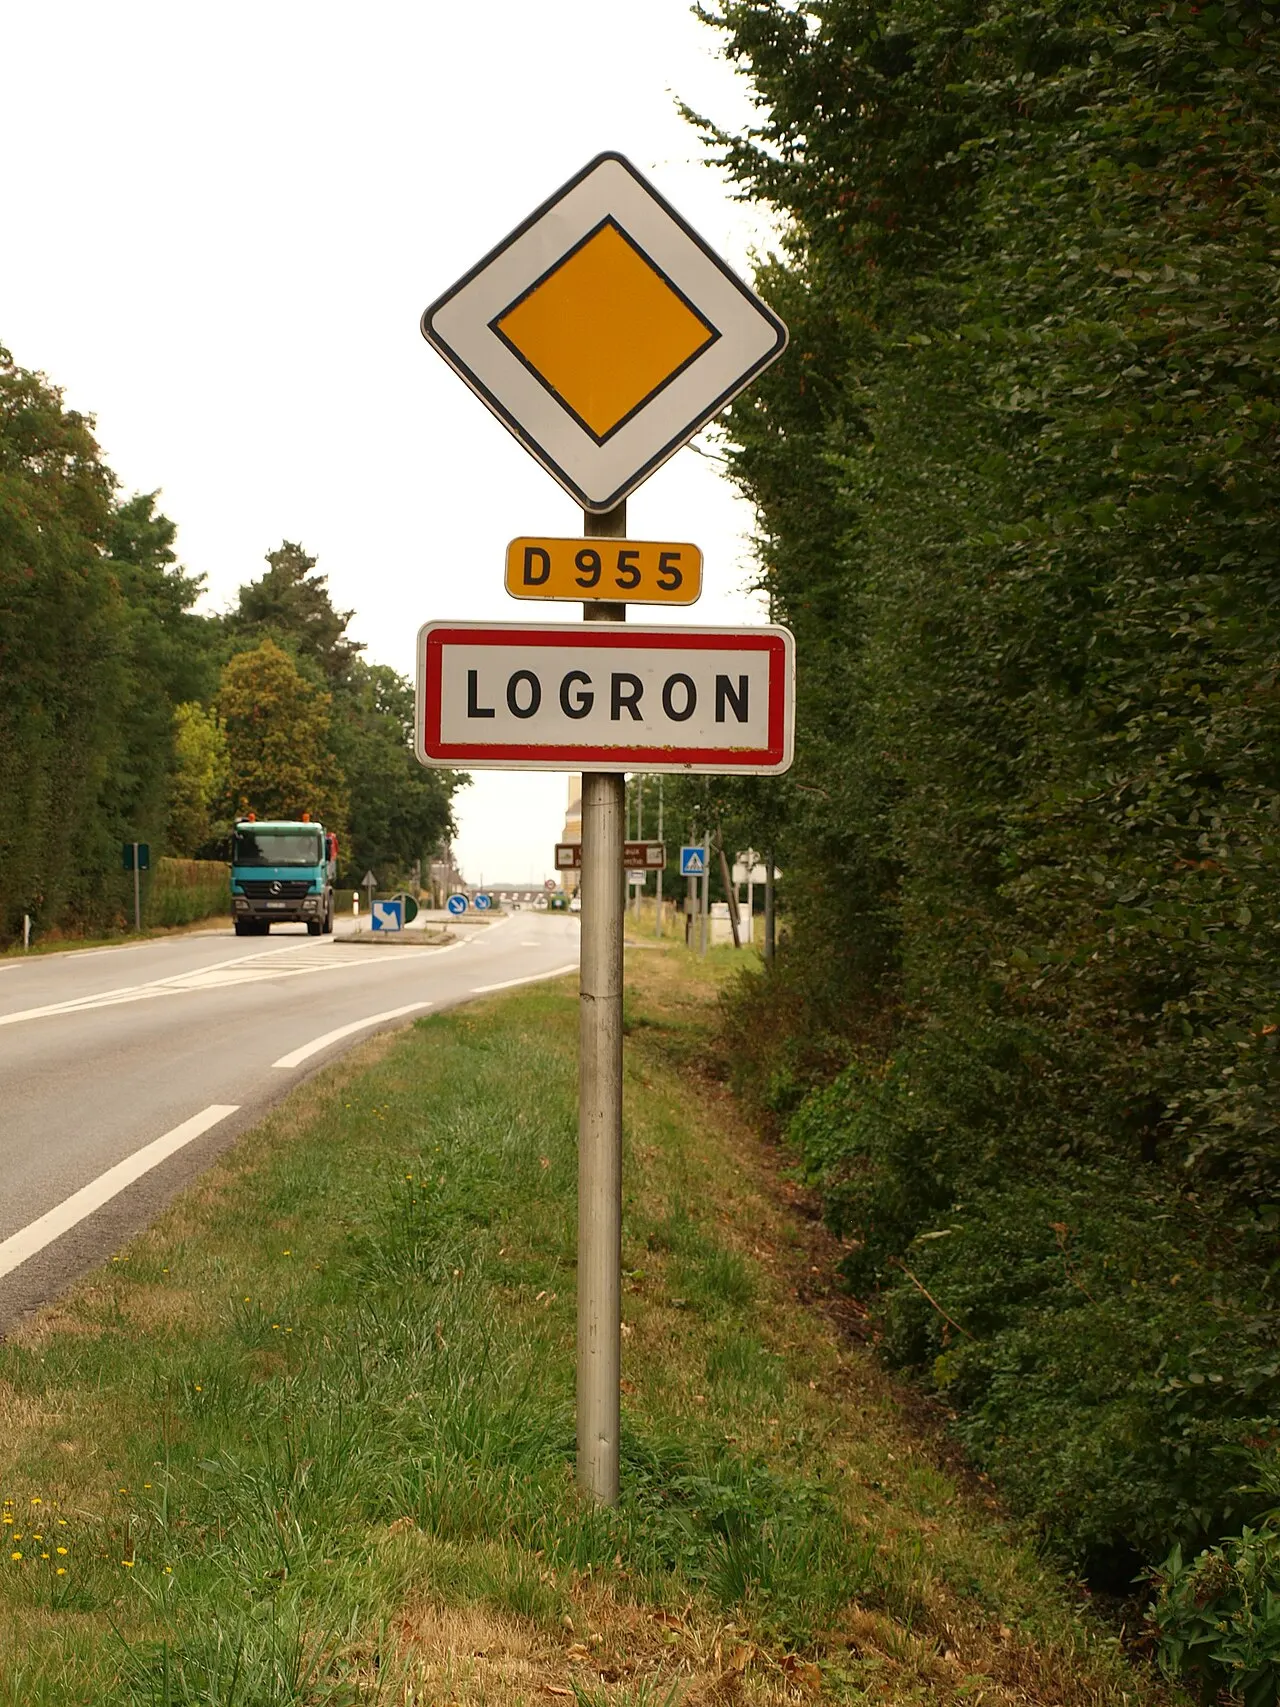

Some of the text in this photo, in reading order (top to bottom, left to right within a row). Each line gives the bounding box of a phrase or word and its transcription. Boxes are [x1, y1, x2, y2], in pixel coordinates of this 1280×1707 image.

[523, 547, 683, 591] D 955
[467, 669, 749, 723] LOGRON
